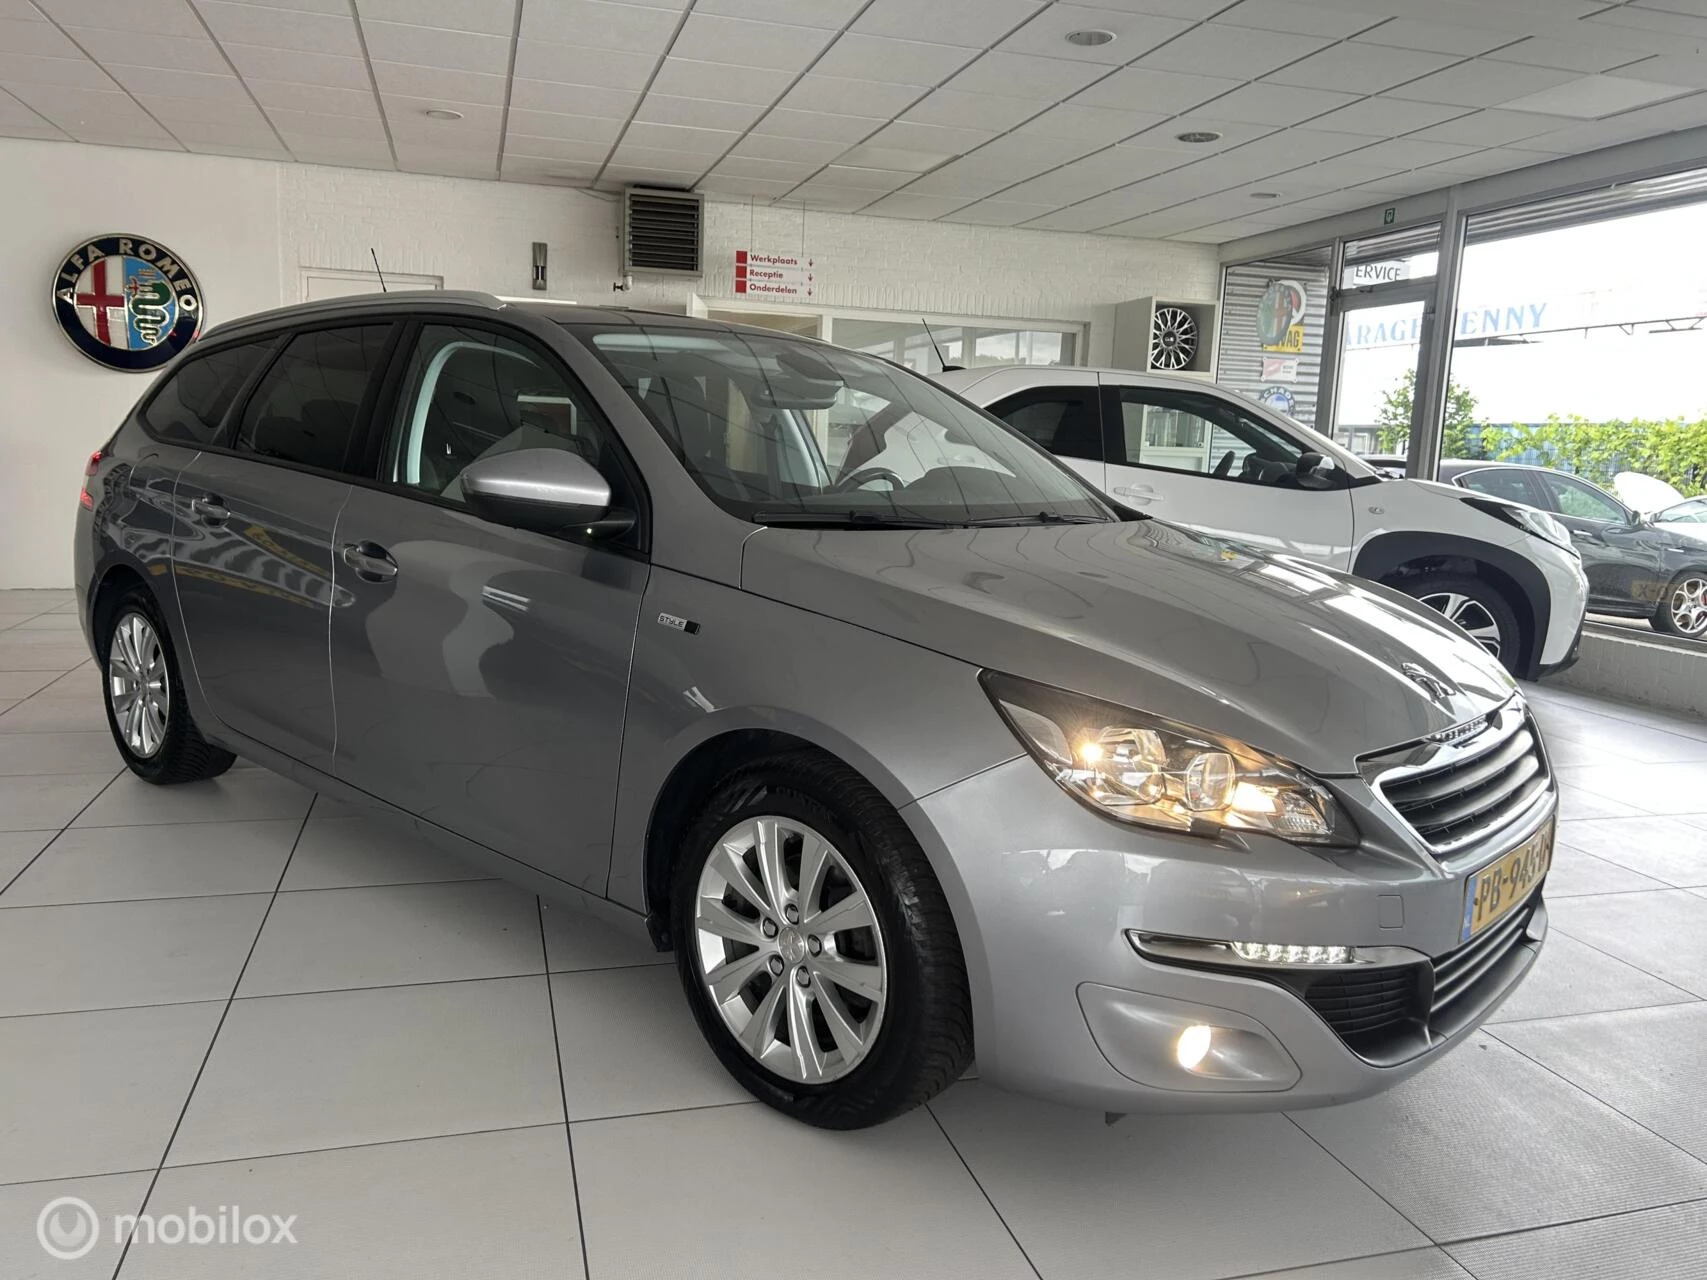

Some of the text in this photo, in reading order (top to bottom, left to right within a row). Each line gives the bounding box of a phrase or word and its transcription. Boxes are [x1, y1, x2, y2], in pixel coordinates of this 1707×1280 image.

[750, 254, 798, 265] Werkplaats
[56, 238, 197, 311] ALFA ROMEO
[749, 269, 784, 279] Receptie
[1355, 264, 1400, 281] ERVICE
[749, 283, 797, 294] Onderdelen
[1460, 302, 1548, 335] ENNY
[659, 615, 685, 628] STYLE
